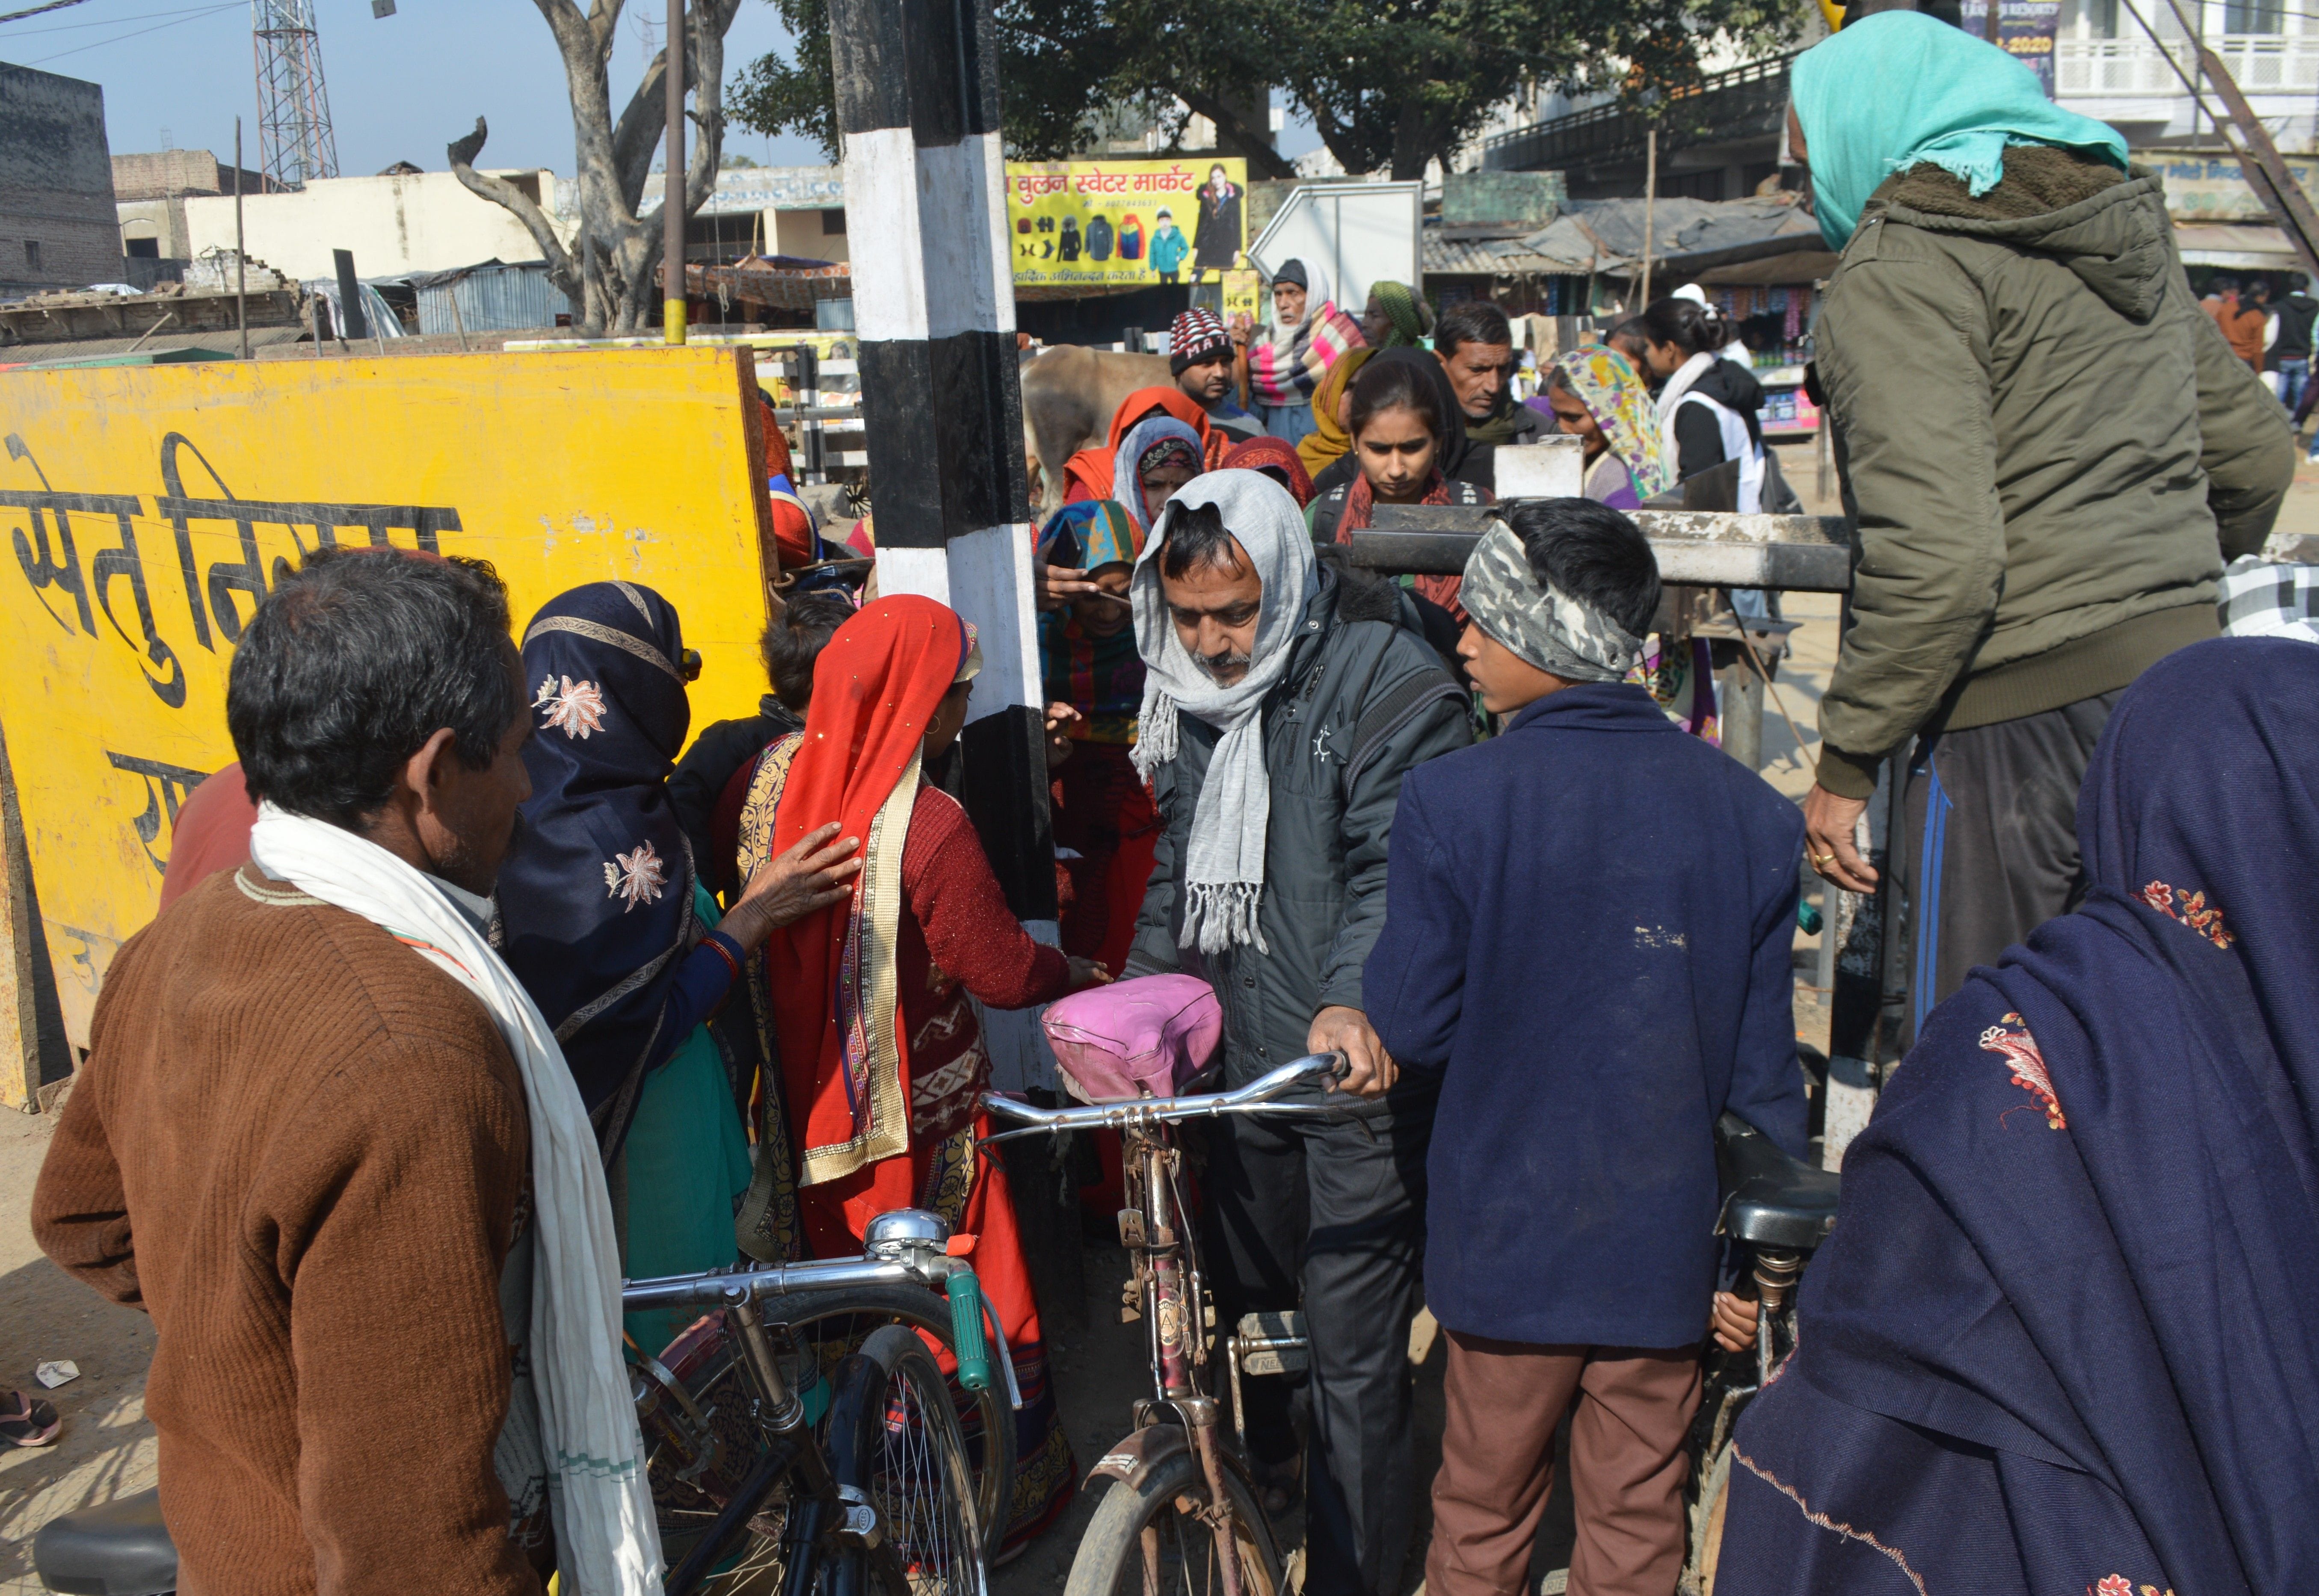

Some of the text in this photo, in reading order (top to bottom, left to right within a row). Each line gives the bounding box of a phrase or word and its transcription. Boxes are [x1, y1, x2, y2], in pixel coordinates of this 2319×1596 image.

[1017, 175, 1069, 204] वुलन
[1075, 167, 1128, 193] स्वेटर
[1133, 164, 1194, 191] मार्केट
[1107, 271, 1135, 281] करता
